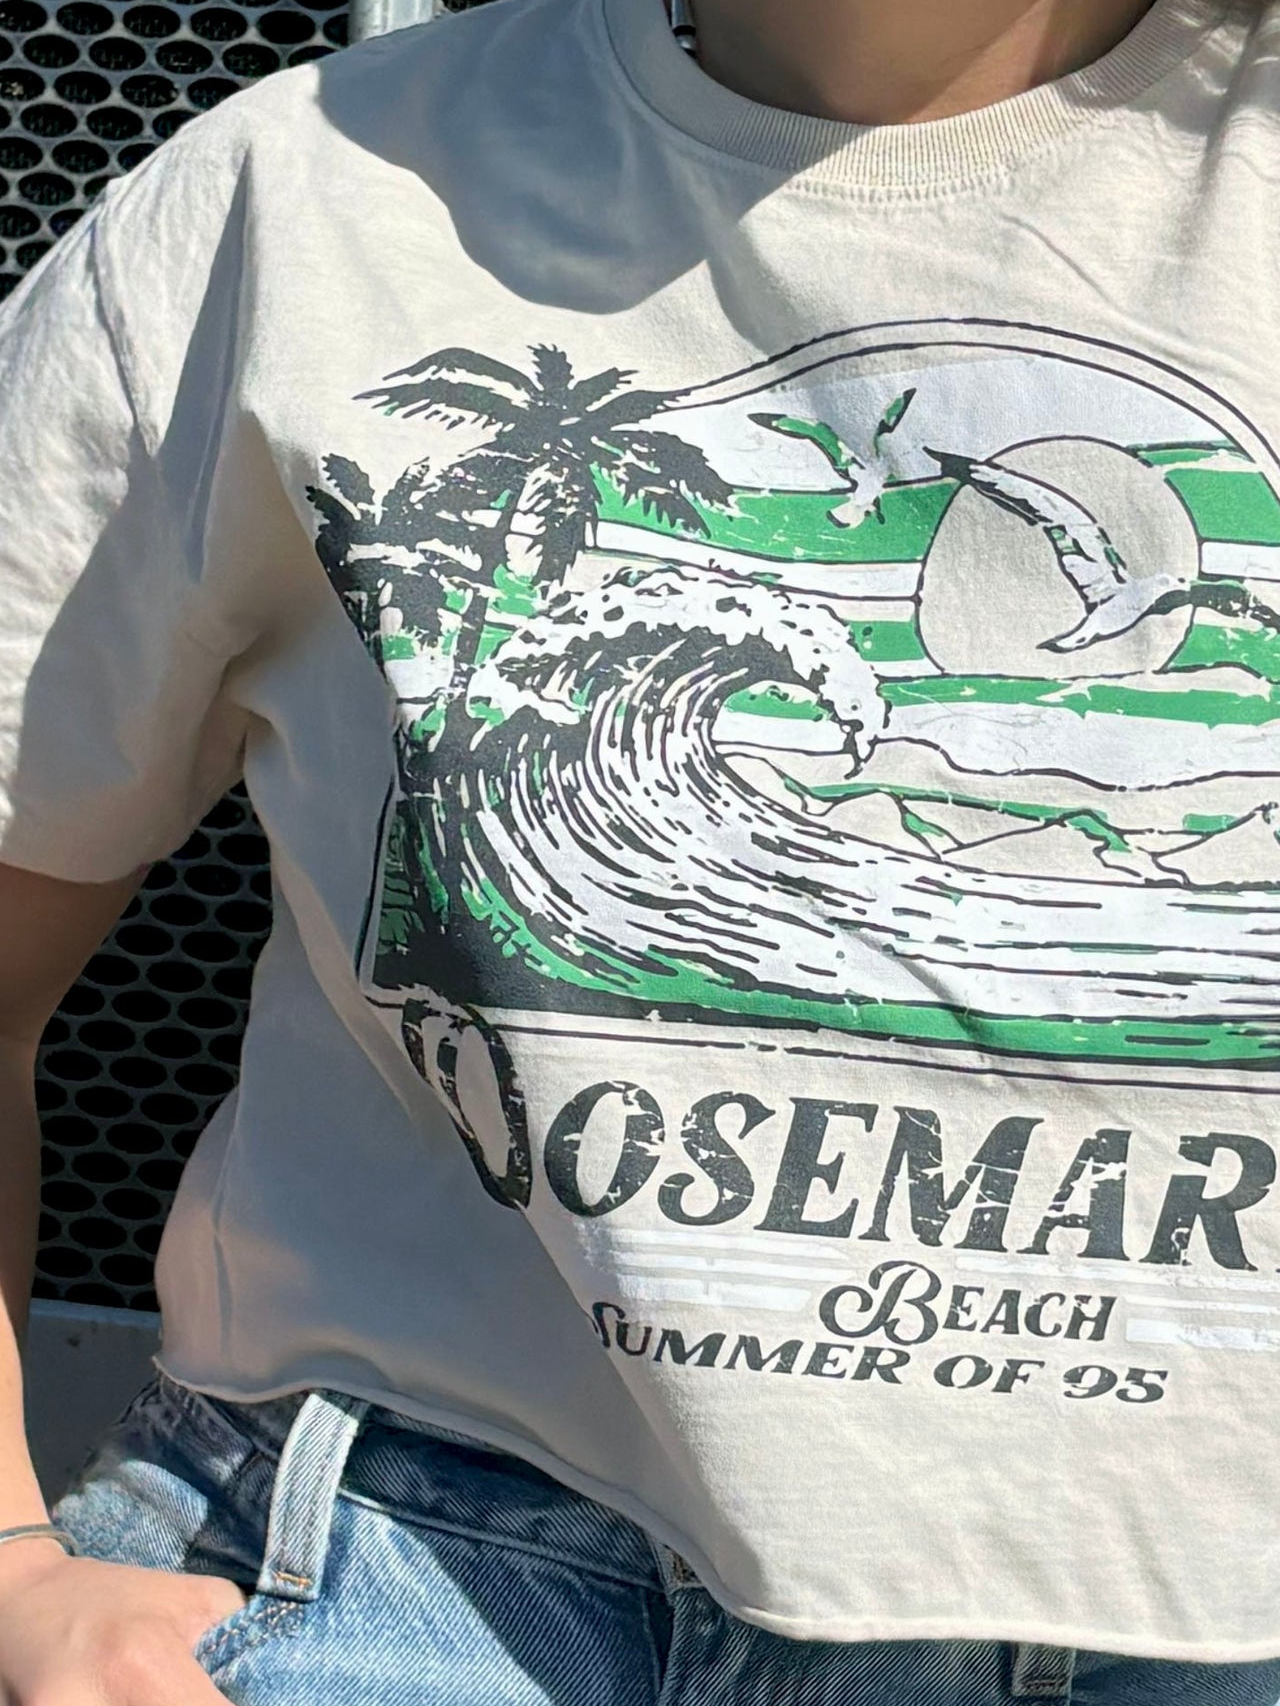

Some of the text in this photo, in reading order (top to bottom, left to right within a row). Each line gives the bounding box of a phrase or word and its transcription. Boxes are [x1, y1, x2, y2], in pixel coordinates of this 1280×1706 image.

[817, 1259, 1117, 1346] BEACH
[932, 1353, 1046, 1394] OF
[1062, 1363, 1170, 1404] 95
